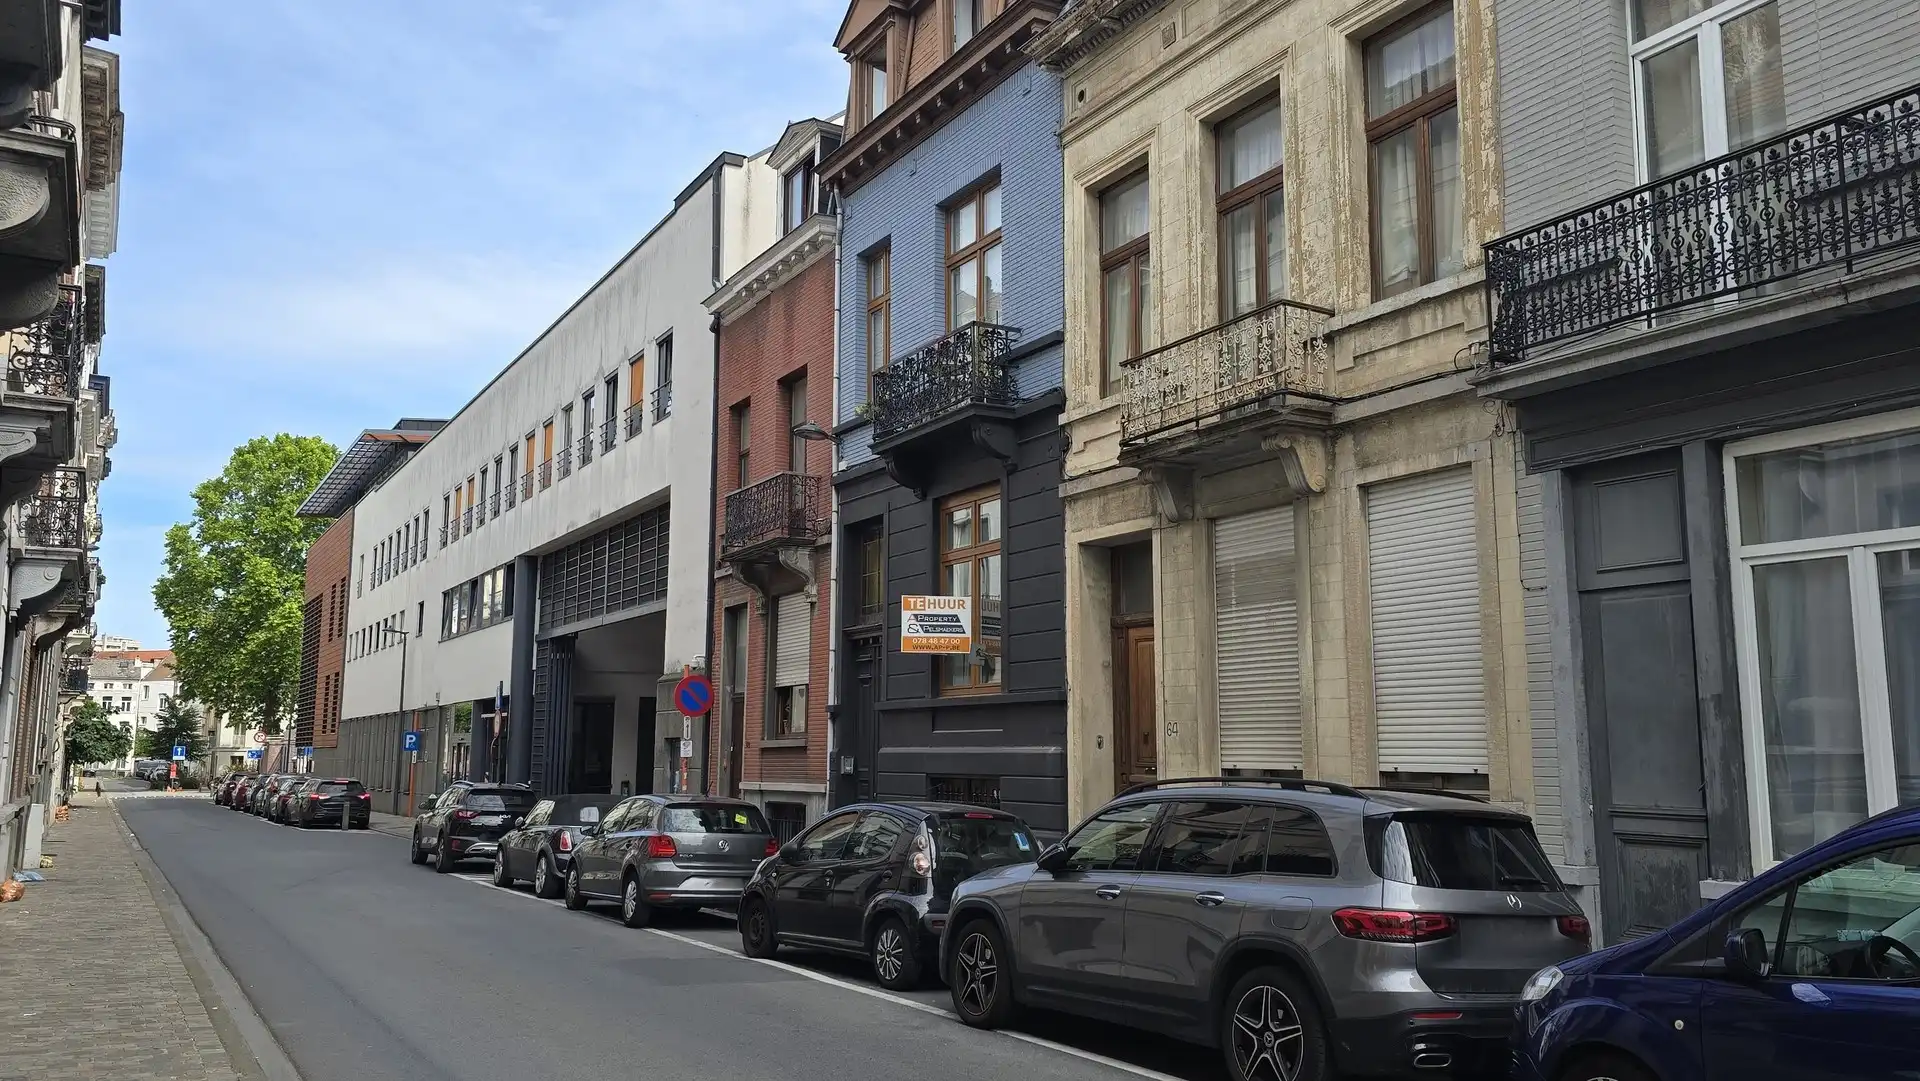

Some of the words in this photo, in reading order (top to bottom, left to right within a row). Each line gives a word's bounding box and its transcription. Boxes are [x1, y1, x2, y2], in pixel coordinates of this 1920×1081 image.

[908, 598, 925, 610] TE
[927, 598, 966, 610] HUUR
[907, 623, 920, 634] &
[1166, 721, 1178, 737] 64
[405, 734, 417, 749] P
